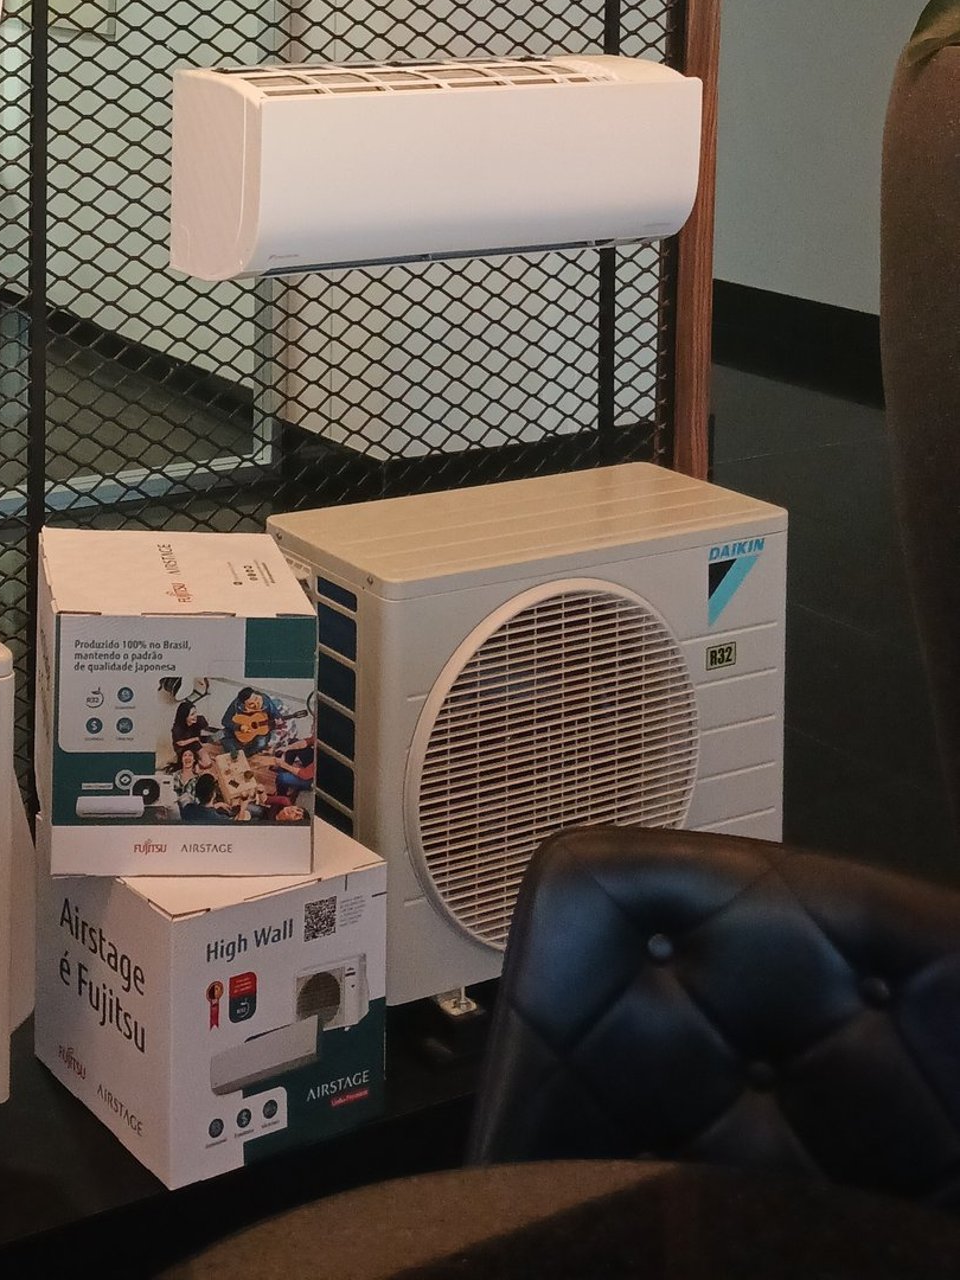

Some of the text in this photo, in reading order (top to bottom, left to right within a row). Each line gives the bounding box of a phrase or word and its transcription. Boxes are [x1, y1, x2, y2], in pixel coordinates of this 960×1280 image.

[709, 537, 765, 560] DAIKIN
[74, 639, 120, 649] Produzido
[122, 640, 147, 649] 100%
[163, 640, 191, 650] Brasil,
[74, 651, 121, 660] mantendo
[131, 651, 163, 661] padrão
[709, 646, 733, 666] R32
[73, 662, 176, 674] de qualidade japonesa
[134, 838, 233, 855] FUJITSU AIRSTAGE
[60, 898, 145, 996] Airstage
[206, 918, 294, 963] High Wall
[59, 951, 145, 1054] é Fujitsu
[306, 1069, 370, 1102] AIRSTAGE
[97, 1084, 144, 1137] AIRSTAGE
